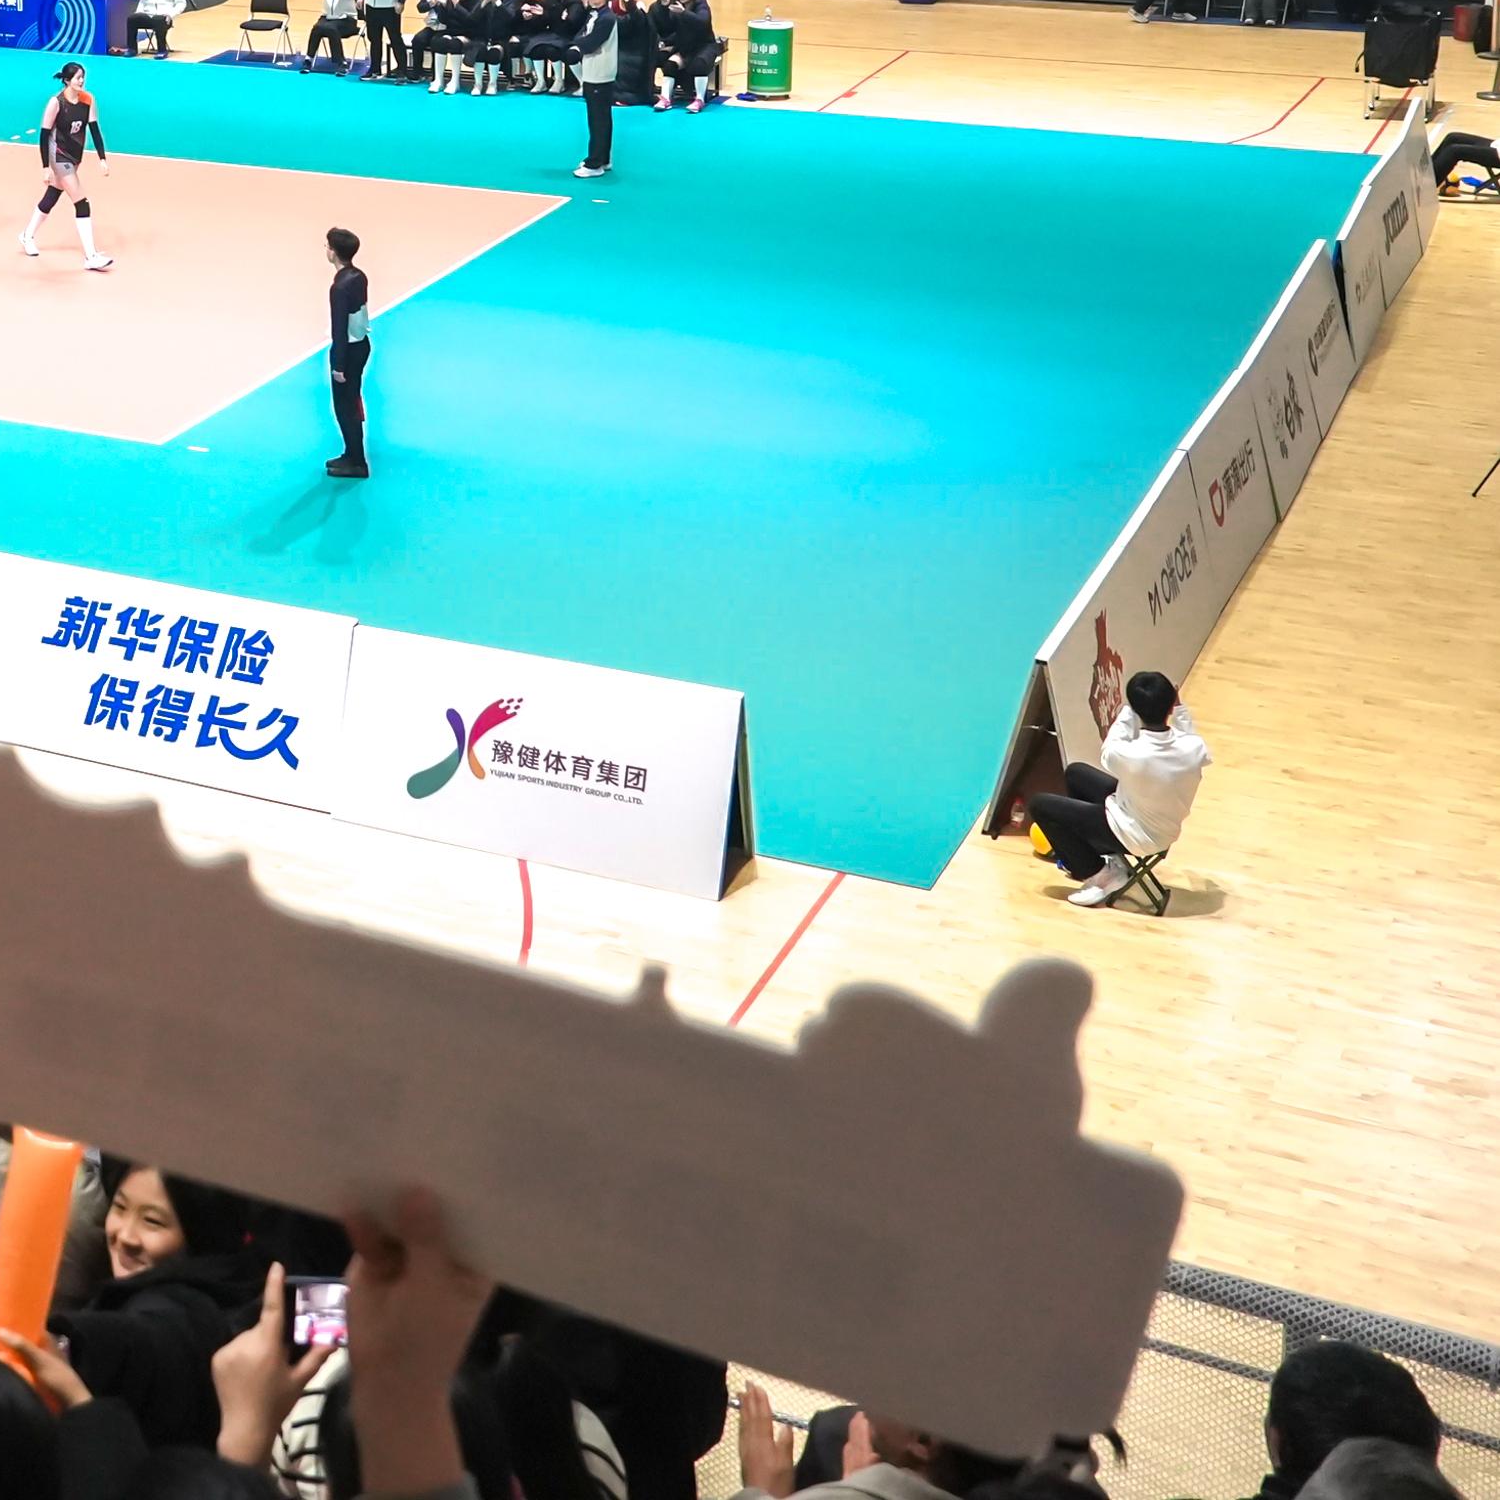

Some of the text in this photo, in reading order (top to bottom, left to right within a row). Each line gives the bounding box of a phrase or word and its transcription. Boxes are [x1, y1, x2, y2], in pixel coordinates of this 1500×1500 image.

[70, 120, 83, 134] 18
[1222, 438, 1256, 510] 滴滴出行
[41, 596, 275, 685] 新华保险
[83, 673, 300, 770] 保得长久
[490, 768, 515, 780] YUJIAN
[517, 774, 545, 786] SPORTS
[546, 780, 583, 793] INDUSTRY
[585, 787, 611, 798] GROUP
[491, 739, 648, 792] 豫健体育集团
